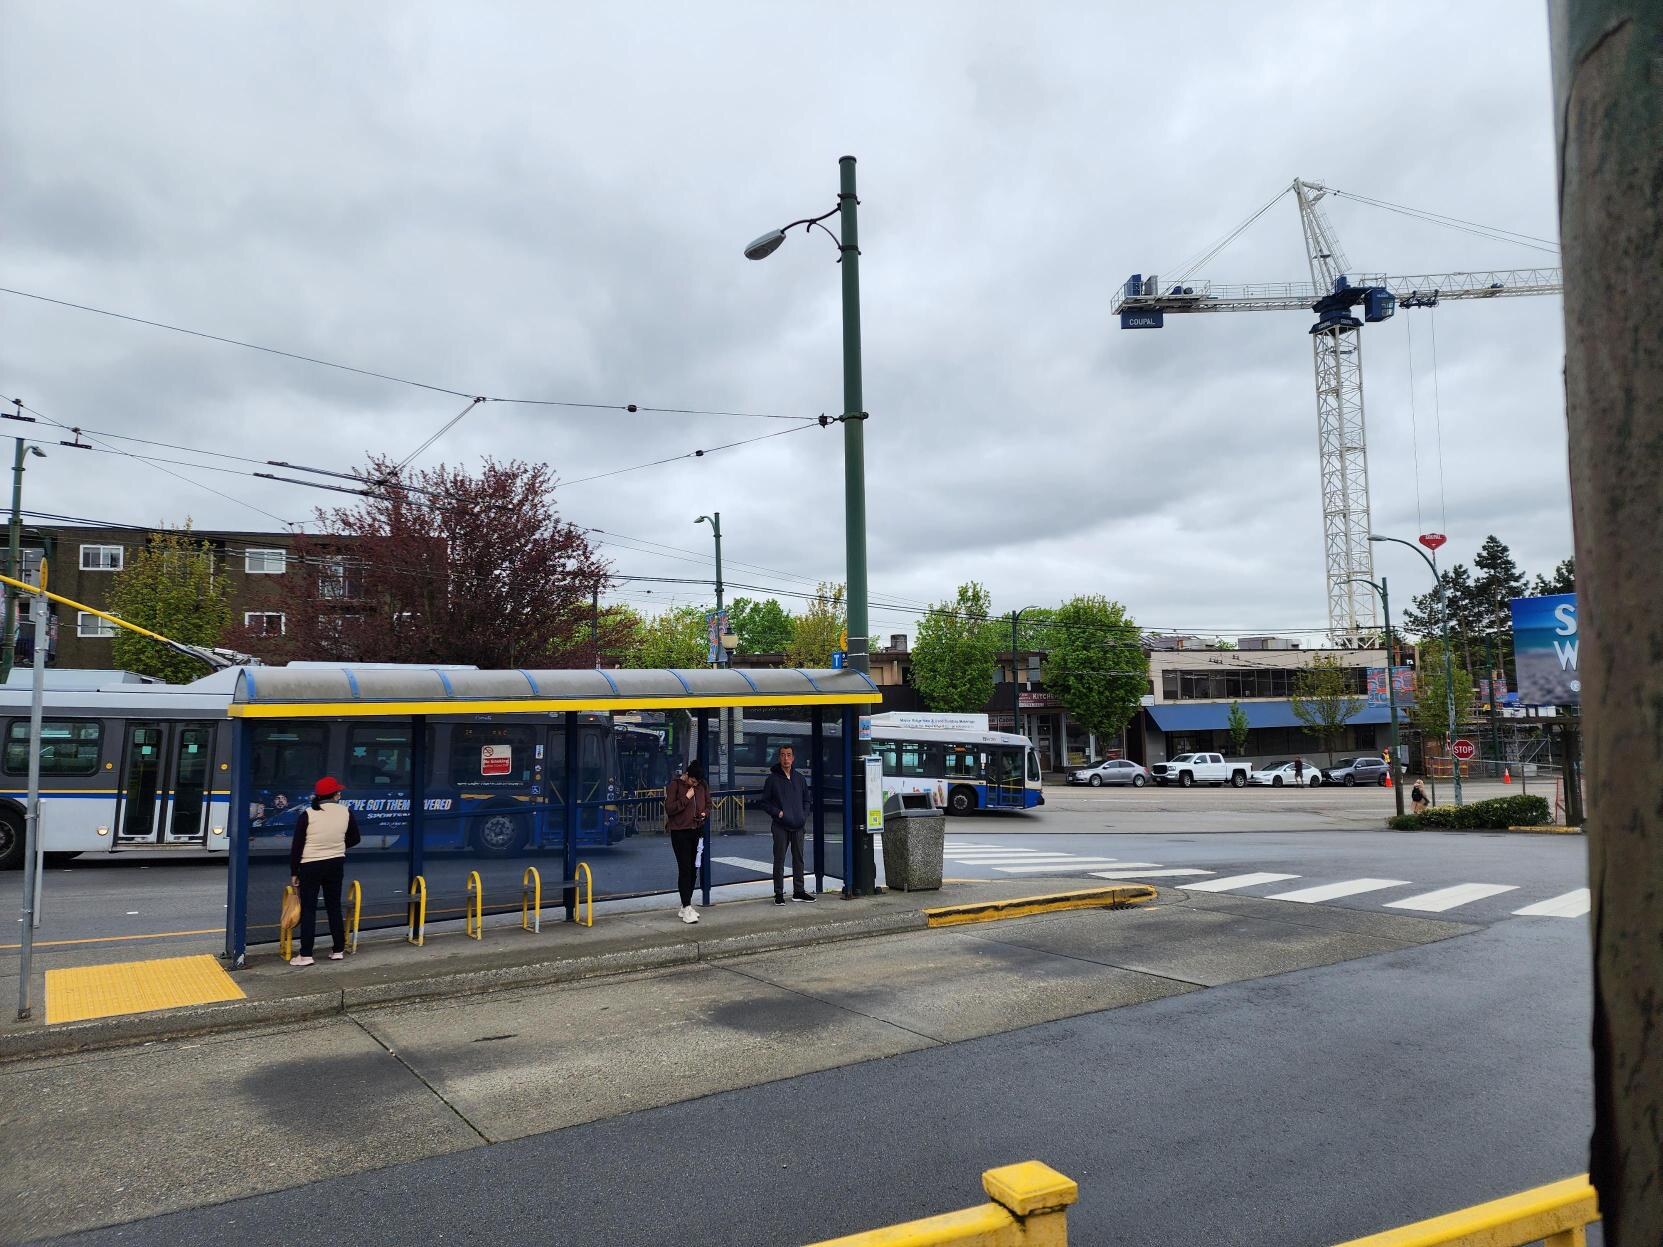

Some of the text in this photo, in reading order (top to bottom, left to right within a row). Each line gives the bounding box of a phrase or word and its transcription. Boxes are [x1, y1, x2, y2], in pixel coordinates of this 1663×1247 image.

[1129, 318, 1156, 326] COUPAL
[1454, 746, 1473, 754] STOP
[366, 800, 385, 811] GOT
[385, 799, 411, 811] THEM
[424, 799, 452, 811] VERED
